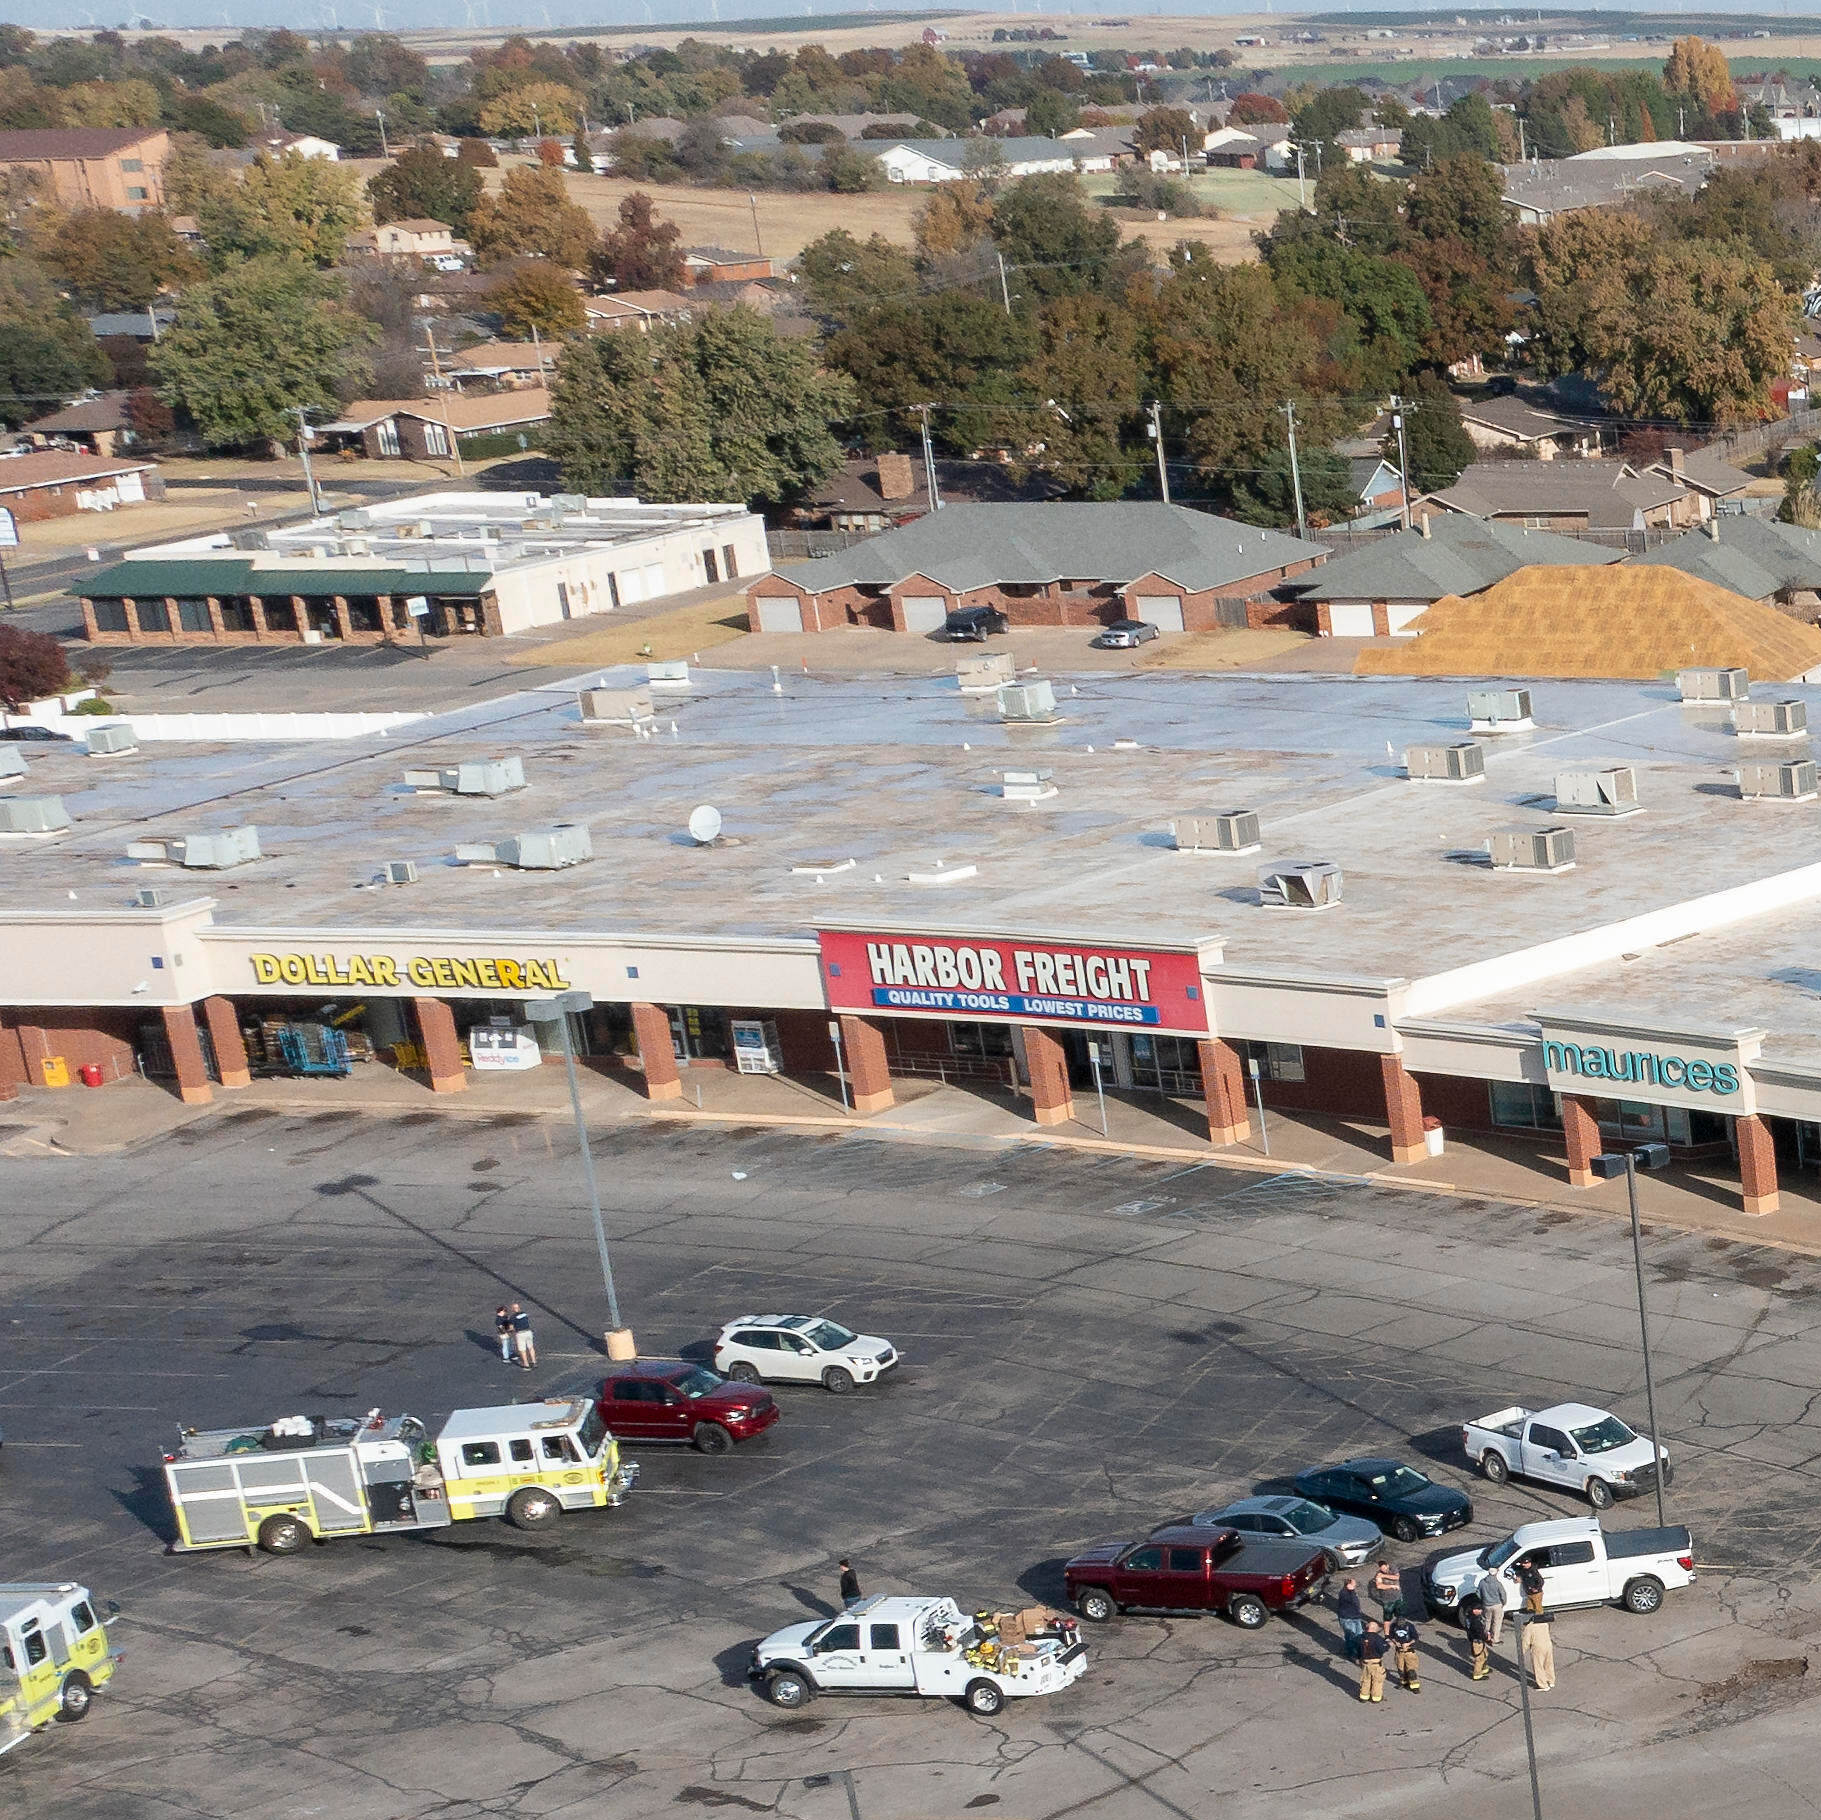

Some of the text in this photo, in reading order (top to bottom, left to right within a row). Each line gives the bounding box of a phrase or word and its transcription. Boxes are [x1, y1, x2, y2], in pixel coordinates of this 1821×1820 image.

[252, 953, 571, 989] DOLLAR GENERAL
[867, 942, 1151, 1002] HARBOR FREIGHT
[888, 990, 1144, 1022] QUALITY TOOLS LOWEST PRICES
[1543, 1039, 1740, 1095] maurices
